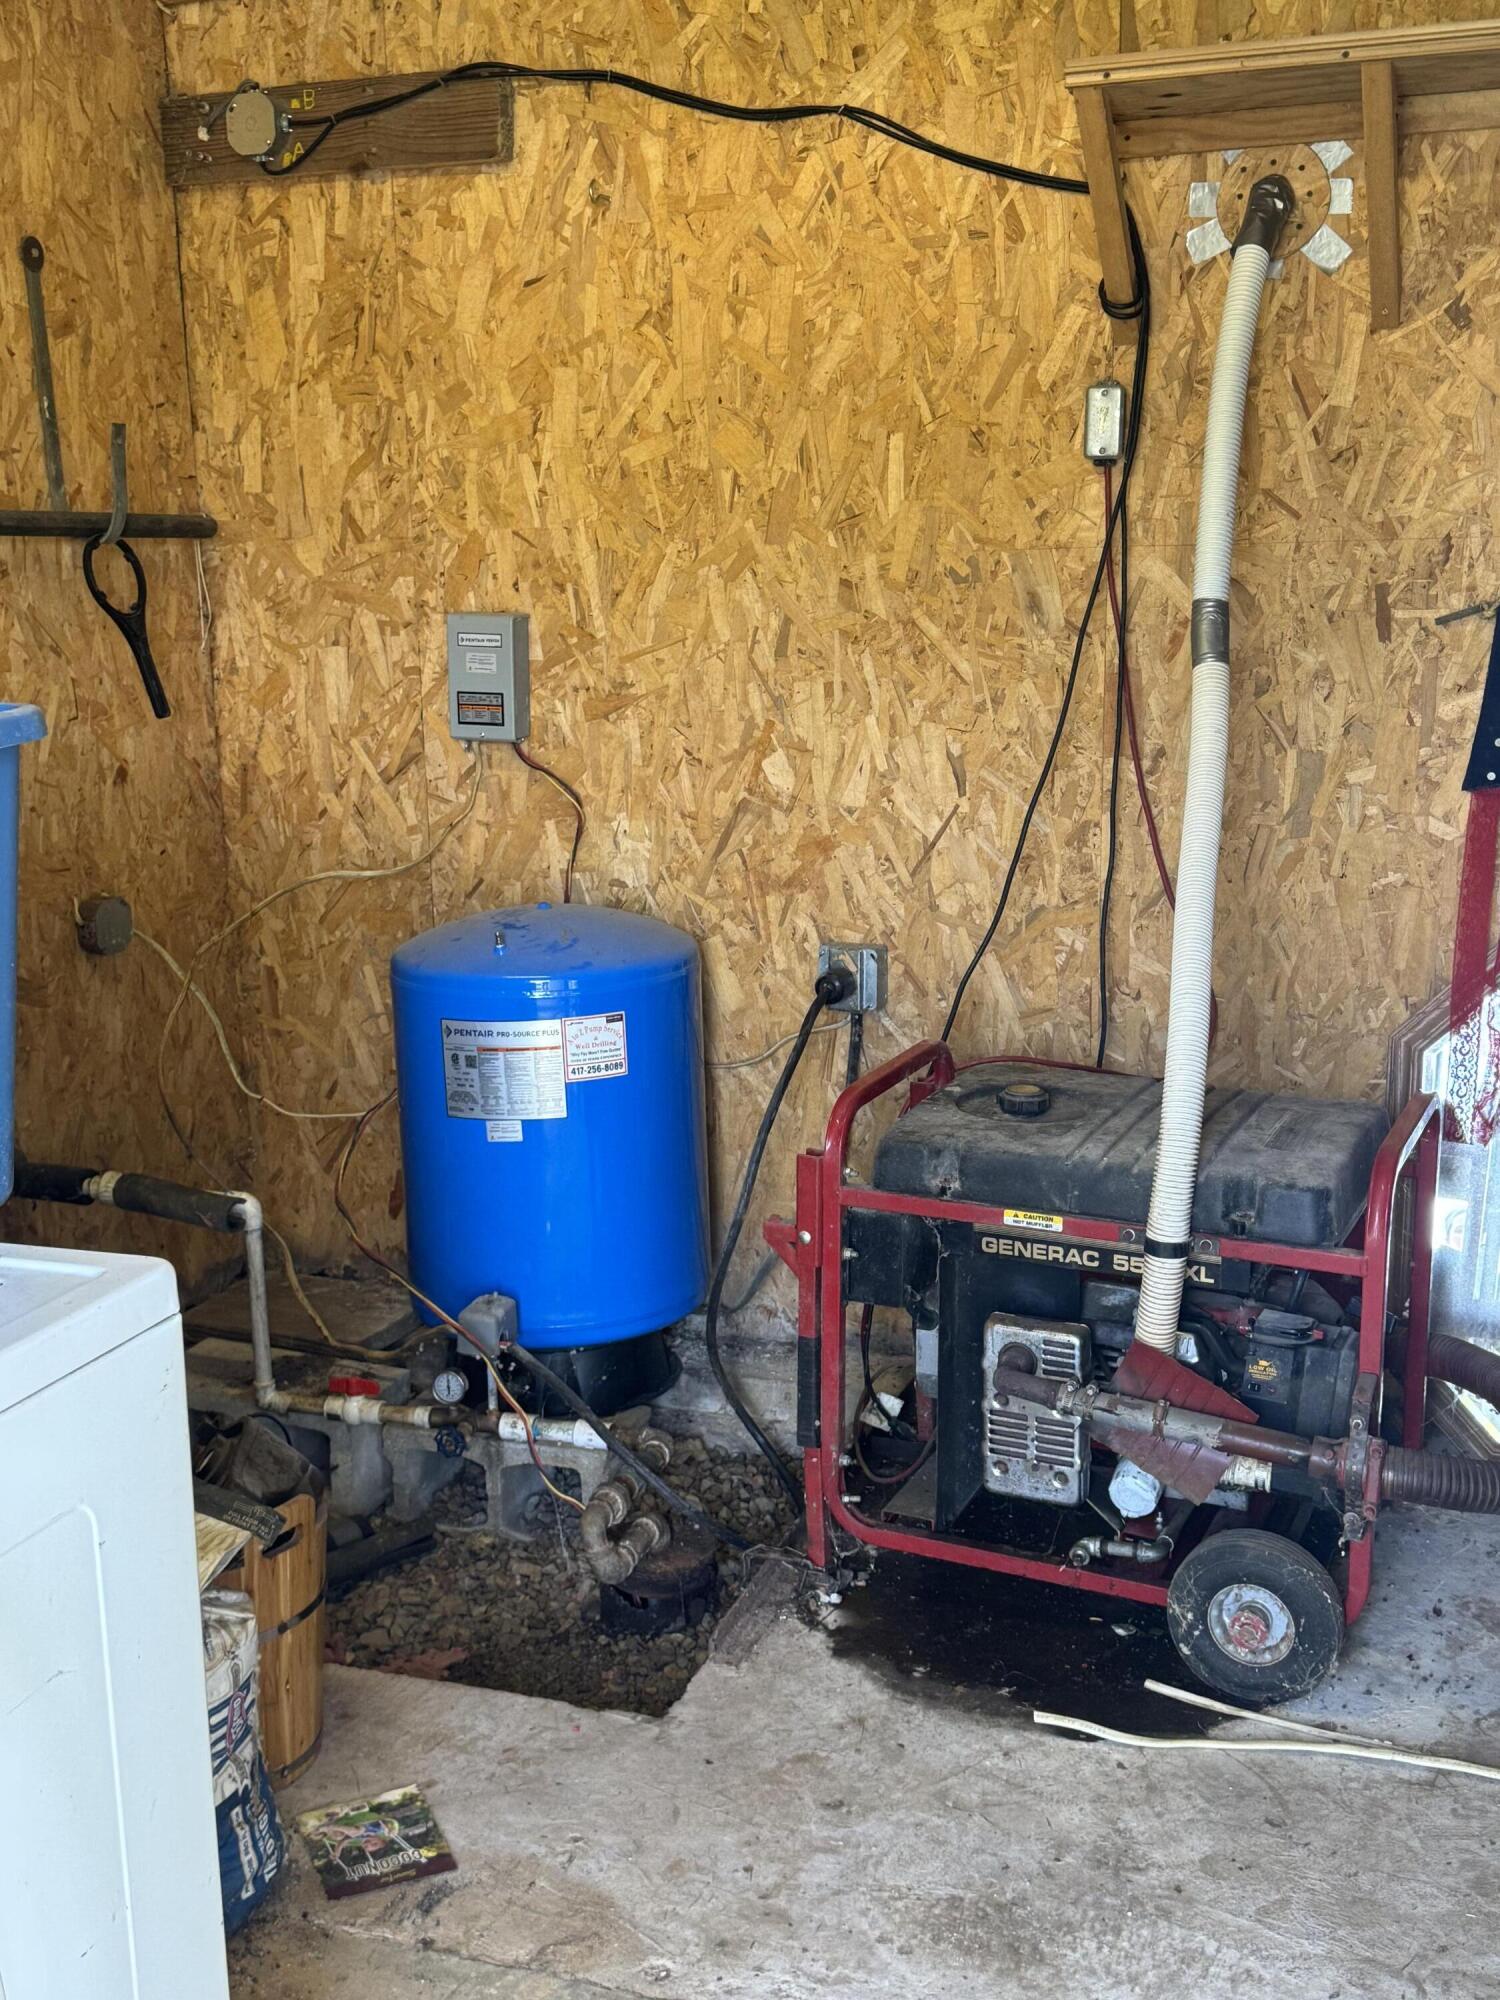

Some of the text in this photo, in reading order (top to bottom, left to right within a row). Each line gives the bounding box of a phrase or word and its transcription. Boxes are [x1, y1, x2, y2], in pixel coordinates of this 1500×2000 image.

[453, 1028, 560, 1038] PENTAIR PRO-SOURCE PLUS
[584, 1025, 603, 1034] Pump
[604, 1025, 623, 1039] Service
[592, 1040, 617, 1049] Drilling
[570, 1061, 624, 1075] 417-256-8089
[1023, 1213, 1054, 1223] CAUTION
[1025, 1220, 1053, 1229] MUFFLER
[981, 1236, 1100, 1267] GENERAC
